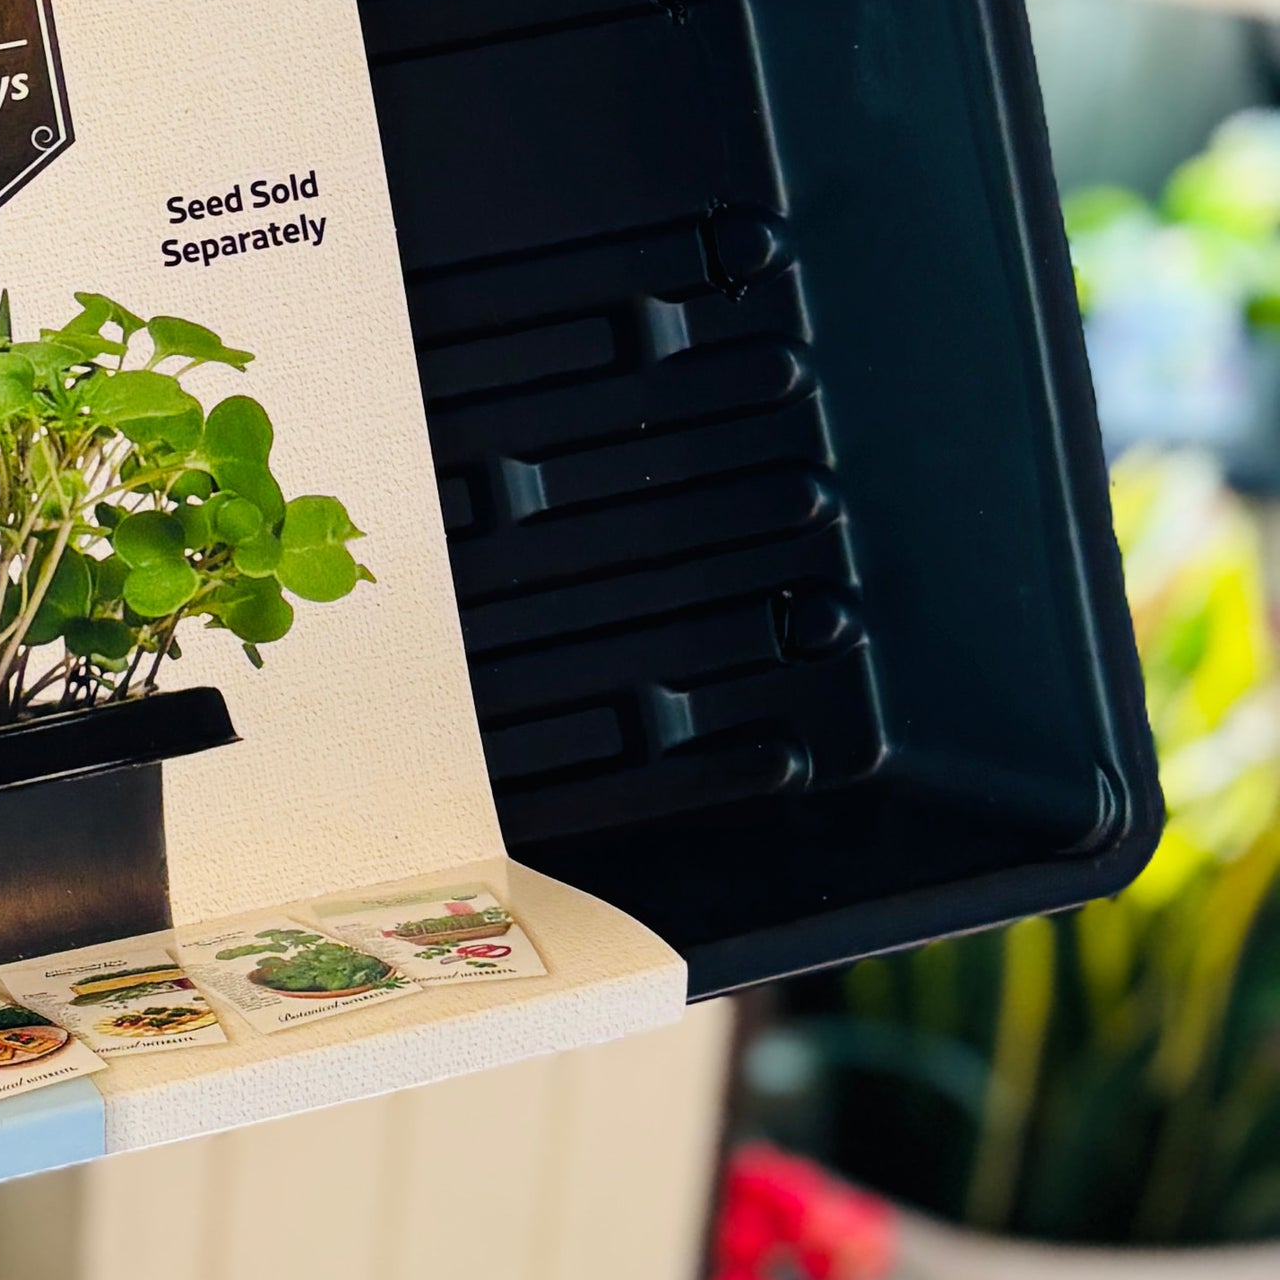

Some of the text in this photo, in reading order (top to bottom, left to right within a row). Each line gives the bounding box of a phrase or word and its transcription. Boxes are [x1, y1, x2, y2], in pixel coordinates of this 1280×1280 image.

[166, 170, 319, 224] Seed Sold
[161, 214, 327, 267] Separately
